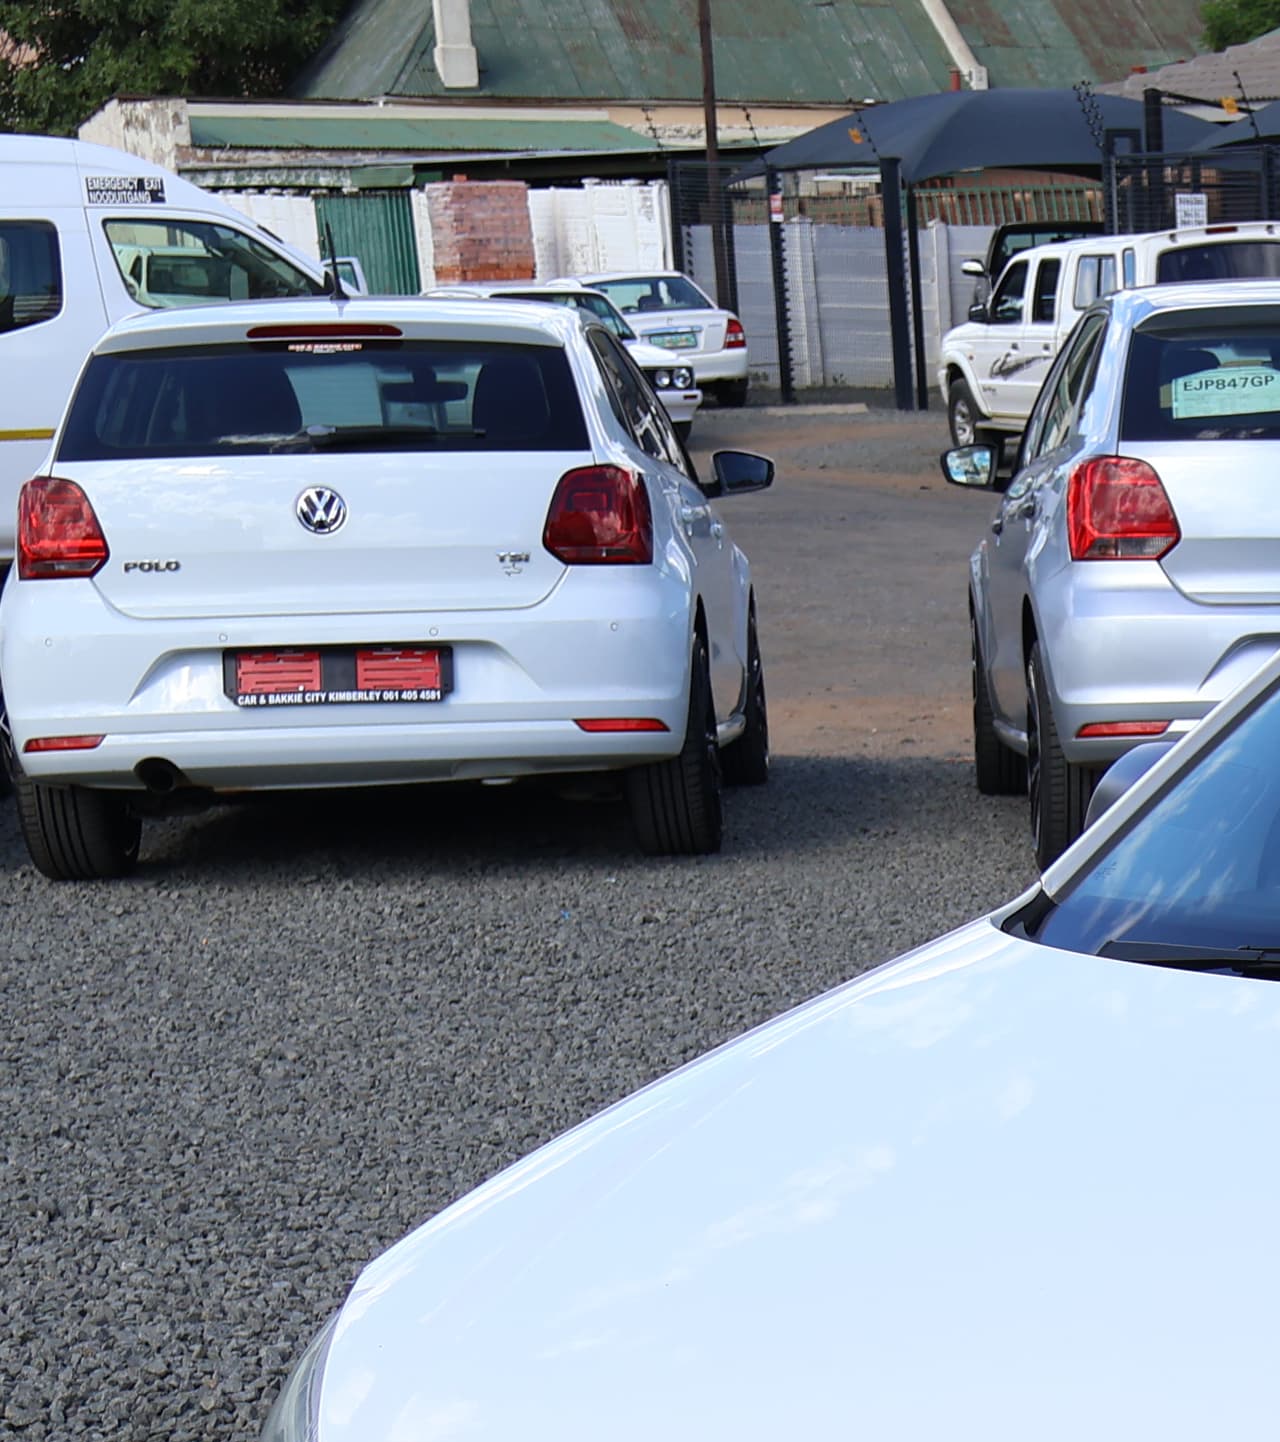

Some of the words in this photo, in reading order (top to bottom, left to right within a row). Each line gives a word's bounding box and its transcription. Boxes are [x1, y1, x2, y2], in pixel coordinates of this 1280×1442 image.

[88, 177, 138, 190] EMERGENCY
[144, 178, 162, 190] EXIT
[1183, 375, 1275, 392] EJP847GP
[123, 560, 181, 573] POLO
[238, 696, 257, 706] CAR
[268, 693, 303, 705] BAKKIE
[305, 692, 326, 703] CITY
[328, 691, 380, 702] KIMBERLEY
[383, 690, 399, 700] 061
[419, 690, 441, 700] 4581
